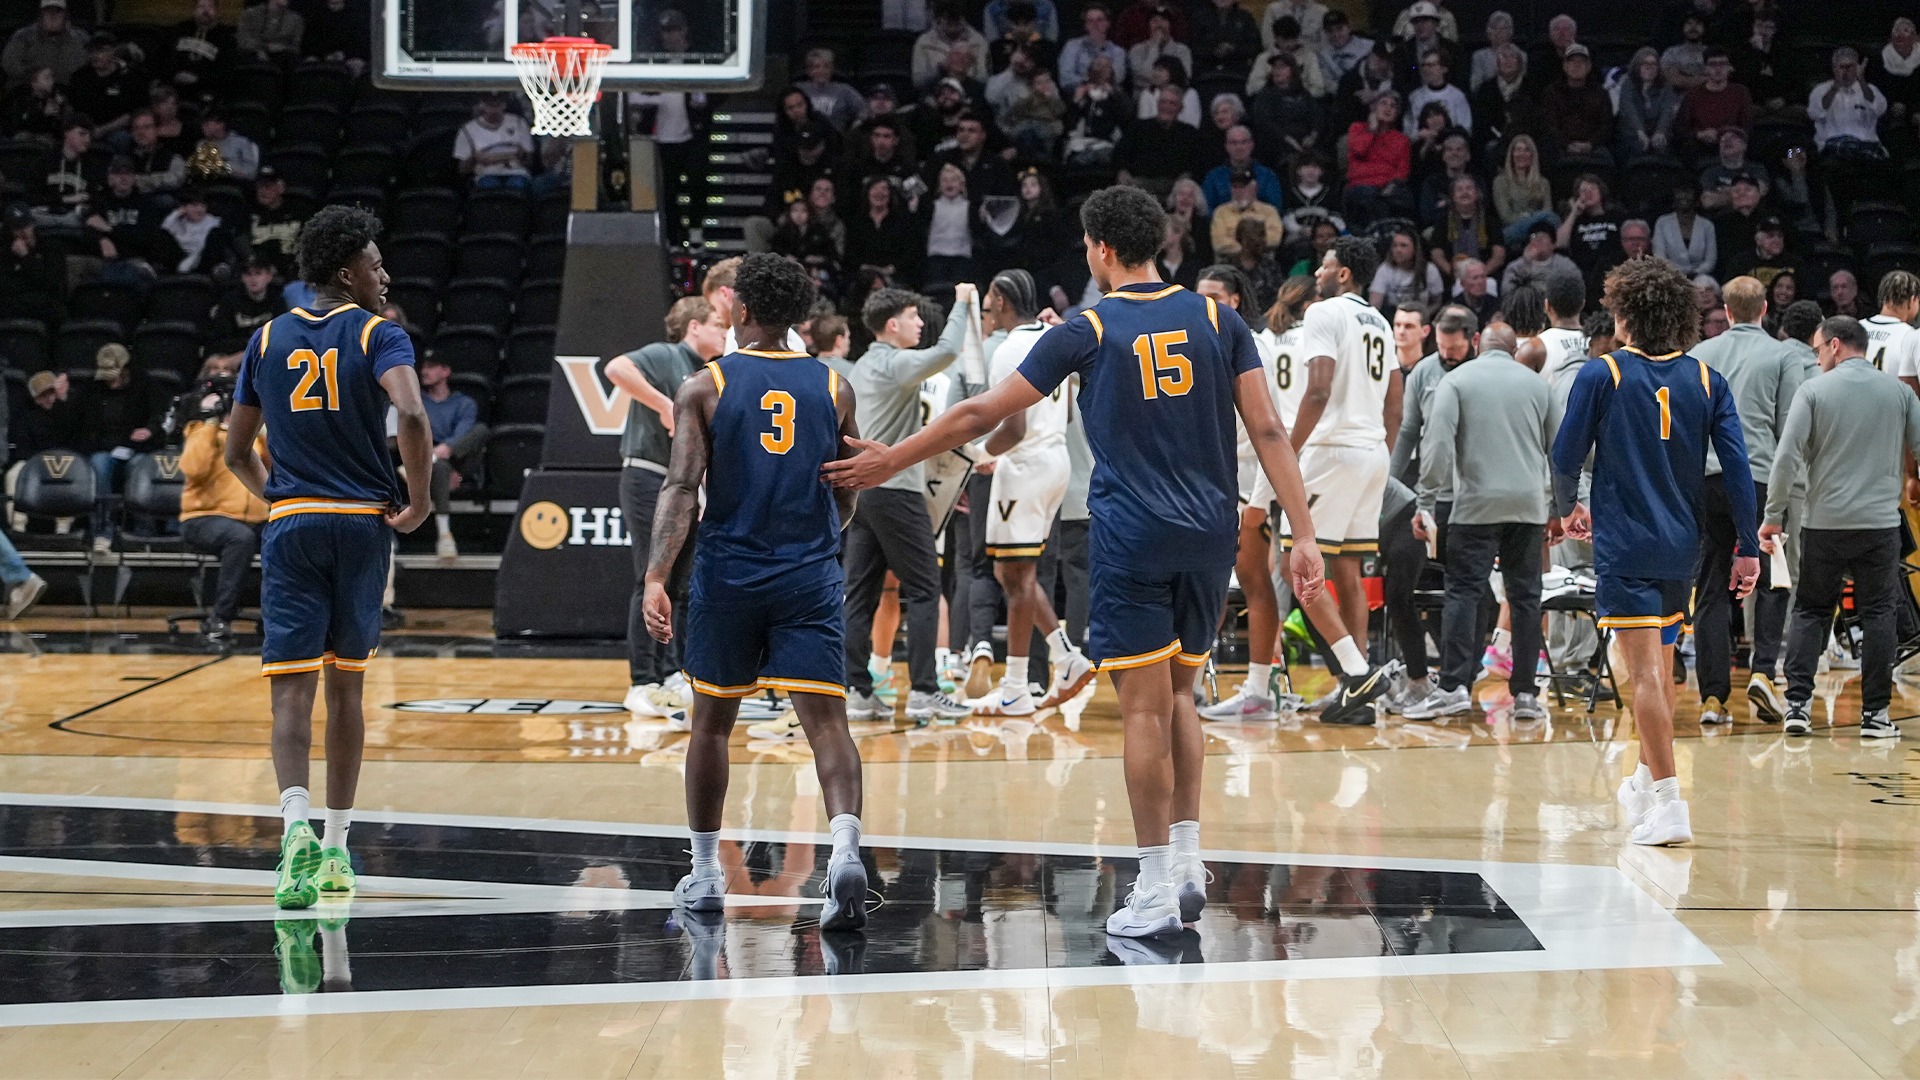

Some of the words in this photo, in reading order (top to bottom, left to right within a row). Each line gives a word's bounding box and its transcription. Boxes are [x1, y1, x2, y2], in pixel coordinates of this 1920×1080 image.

[1132, 329, 1194, 400] 15
[1276, 353, 1292, 390] 8
[1363, 332, 1385, 382] 13
[287, 348, 340, 412] 21
[760, 389, 797, 455] 3
[1655, 386, 1671, 440] 1
[43, 455, 75, 478] V
[154, 455, 181, 479] V
[568, 507, 632, 546] Hi
[998, 500, 1017, 522] V
